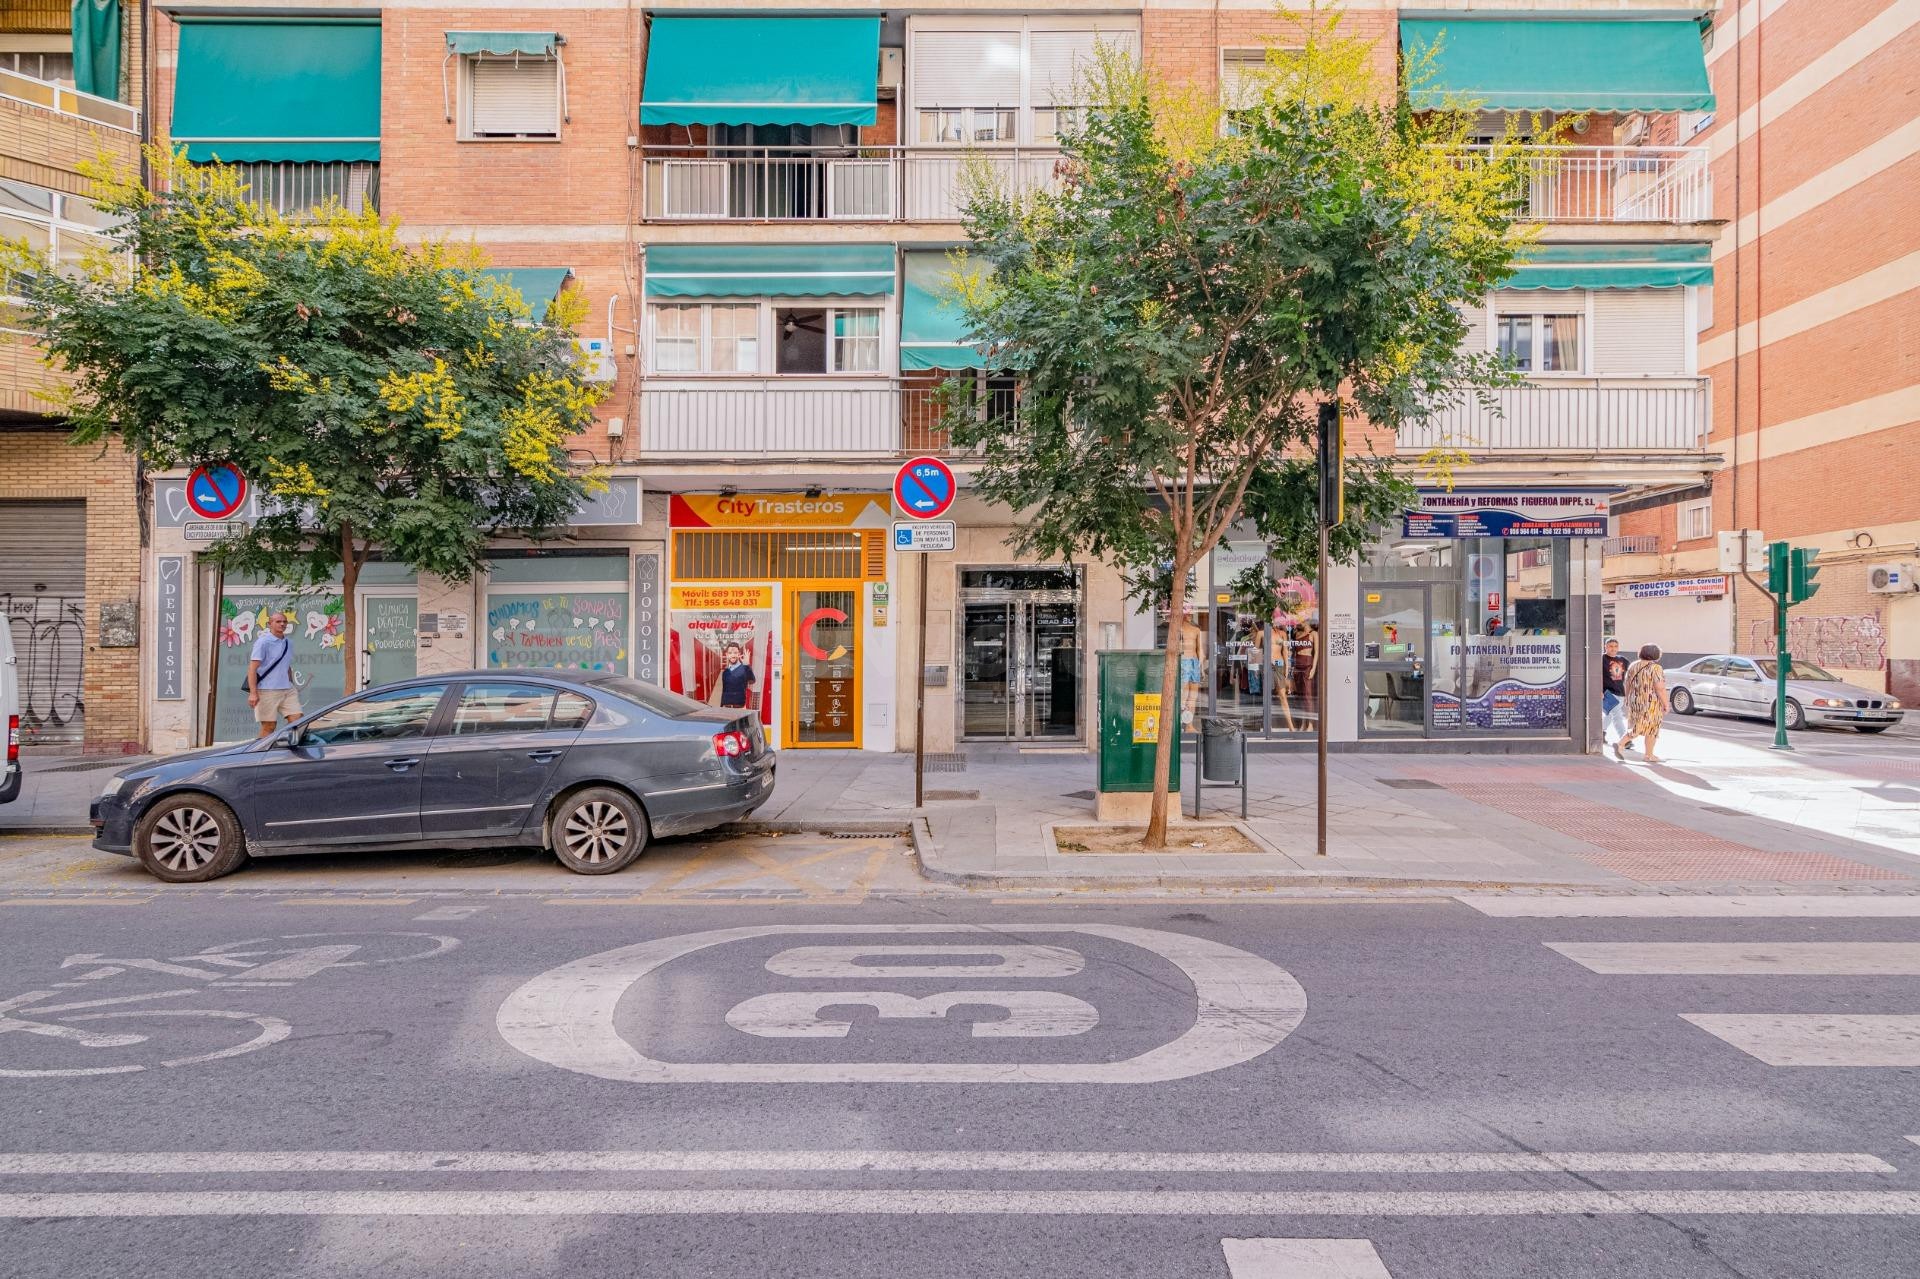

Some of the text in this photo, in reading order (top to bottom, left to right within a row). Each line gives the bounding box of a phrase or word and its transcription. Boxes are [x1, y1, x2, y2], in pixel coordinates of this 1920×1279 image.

[916, 468, 940, 478] 6,5m
[1470, 497, 1476, 507] y
[1477, 497, 1518, 506] REFORMAS
[1521, 496, 1558, 506] FIGUEROA
[717, 499, 844, 517] CityTrasteros
[1629, 580, 1676, 591] PRODUCTOS
[682, 589, 761, 598] Móvil: 689 119 315
[1634, 589, 1670, 598] CASEROS
[703, 599, 720, 607] 955
[488, 600, 540, 627] CUIDAMOS
[377, 616, 412, 629] DENTAL
[687, 620, 728, 631] alquila
[390, 629, 397, 638] Y
[640, 582, 652, 680] PODOLOG
[164, 583, 177, 695] DENTISTA
[1508, 647, 1514, 656] y
[1516, 644, 1561, 655] REFORMAS
[1500, 656, 1530, 665] FIGUEROA
[725, 942, 1100, 1040] 30
